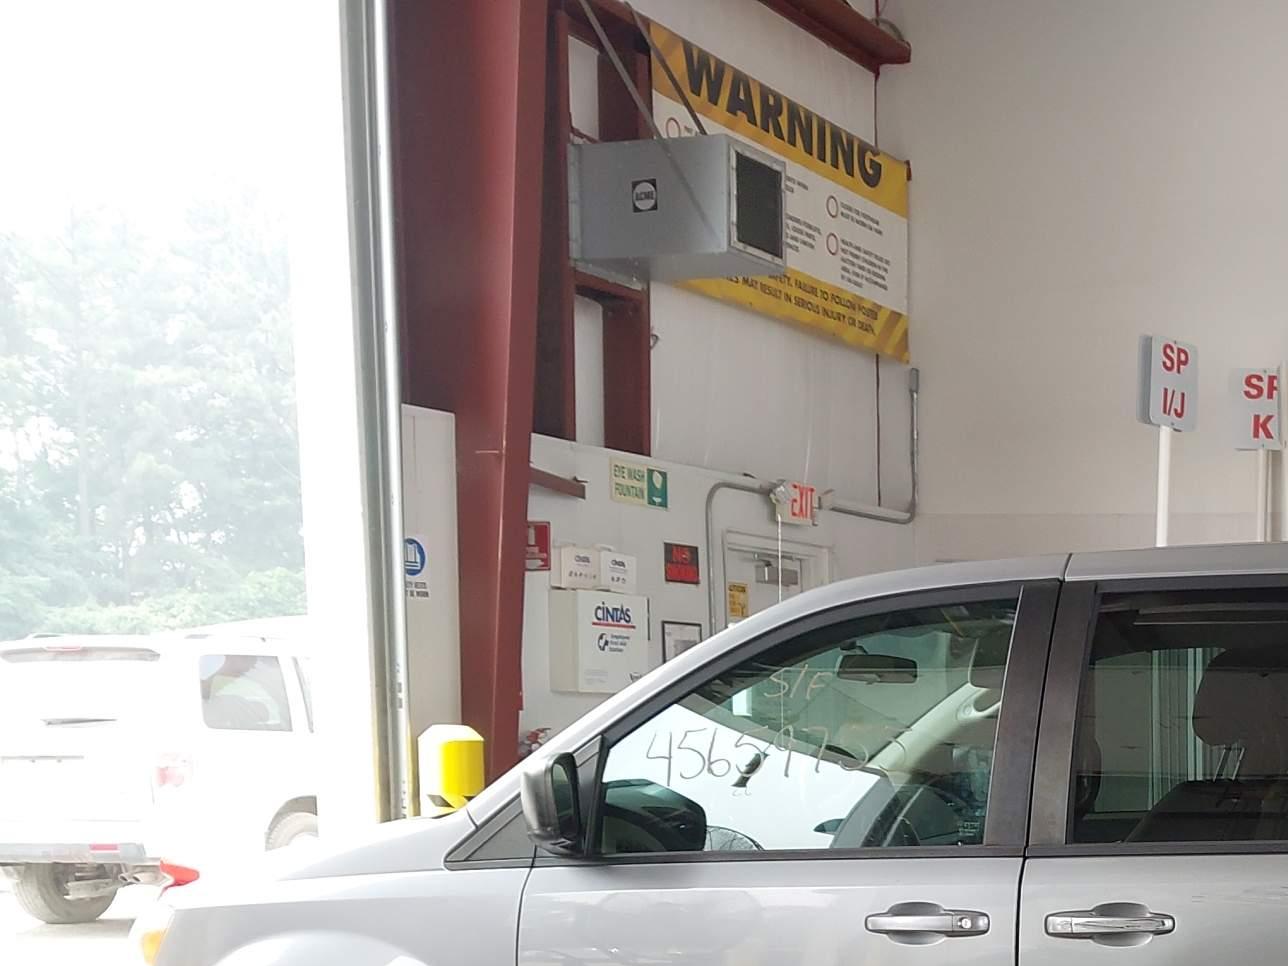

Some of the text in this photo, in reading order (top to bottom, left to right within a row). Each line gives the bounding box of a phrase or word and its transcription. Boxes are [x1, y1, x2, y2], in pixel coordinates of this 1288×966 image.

[683, 36, 882, 188] WARNING
[784, 291, 793, 303] IN
[819, 289, 828, 301] TO
[1162, 343, 1189, 374] SP
[1163, 387, 1185, 419] I/J
[1252, 414, 1274, 440] K
[613, 464, 645, 482] EYE WASH
[615, 482, 645, 499] FOUNTAIN
[791, 483, 815, 520] EXIT
[594, 601, 632, 624] CINTAS
